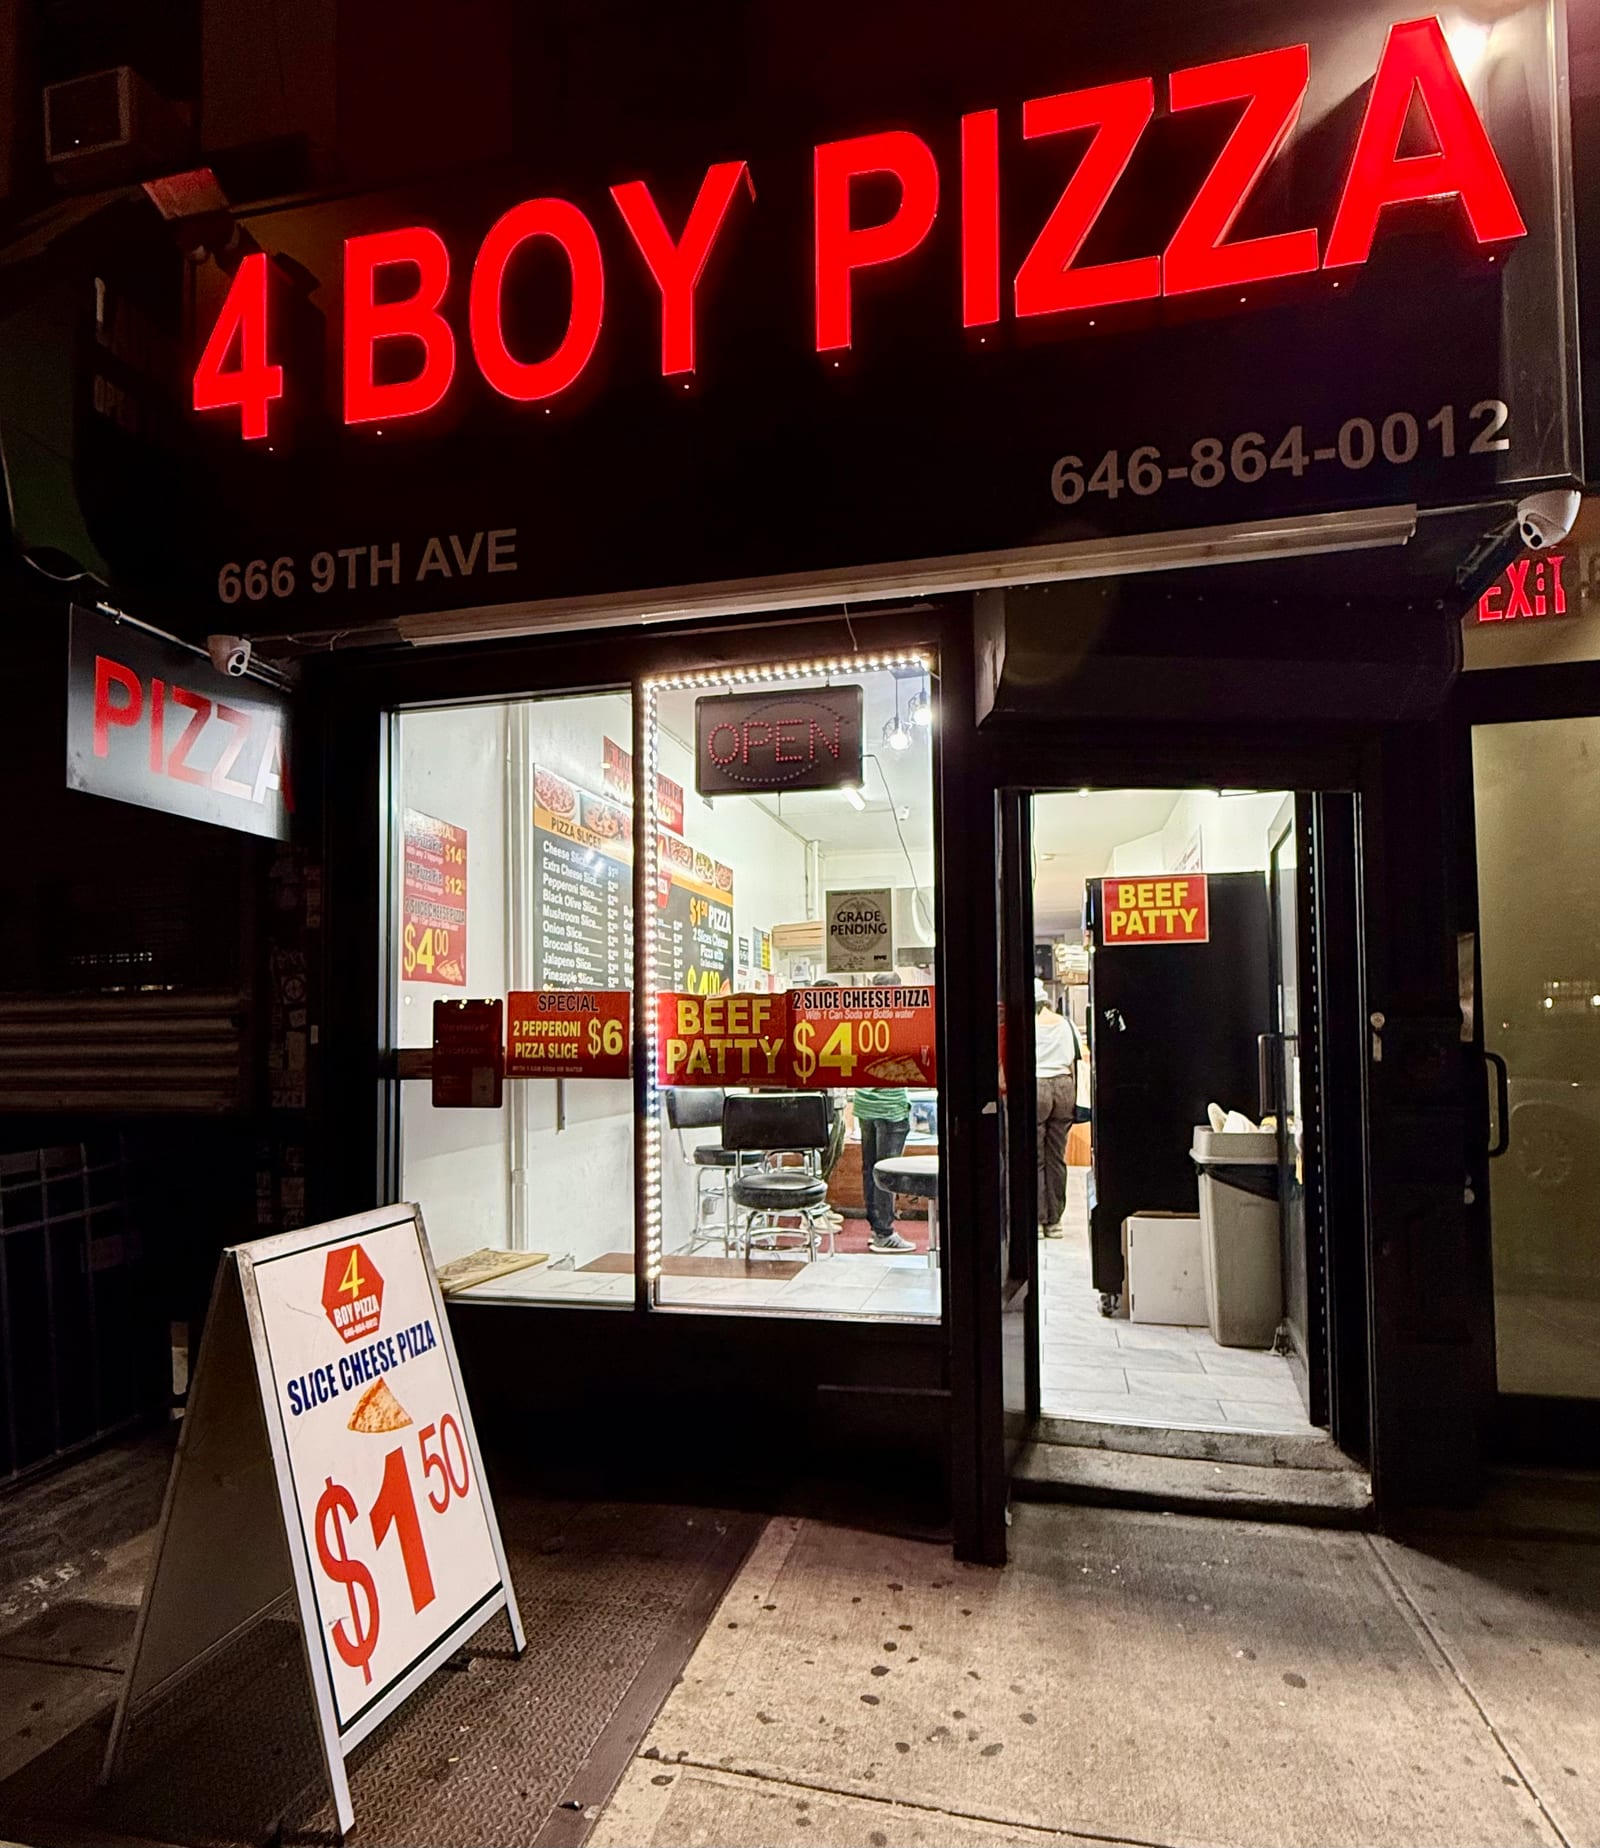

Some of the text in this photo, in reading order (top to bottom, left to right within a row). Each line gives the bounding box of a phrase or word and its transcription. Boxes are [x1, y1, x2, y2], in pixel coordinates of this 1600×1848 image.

[193, 14, 1528, 441] 4 BOY PIZZA
[1050, 400, 1511, 505] 646-864-0012
[218, 528, 518, 604] 666 9TH AVE
[93, 654, 296, 814] PIZZA
[707, 717, 841, 765] OPEN
[551, 817, 576, 840] PIZZA
[543, 840, 570, 861] Cheese
[543, 872, 579, 895] Pepperoni
[543, 888, 563, 905] Black
[1118, 882, 1189, 909] BEEF
[543, 904, 580, 924] Mushroom
[708, 904, 732, 935] PIZZA
[836, 910, 881, 923] GRADE
[1110, 907, 1199, 936] PATTY
[543, 920, 565, 936] Onion
[830, 923, 888, 936] PENDING
[543, 936, 572, 952] Broccoli
[543, 952, 575, 968] Jalapeno
[543, 967, 578, 984] Pineapple
[538, 995, 599, 1012] SPECIAL
[793, 989, 930, 1009] 2 SLICE CHEESE PIZZA
[677, 999, 771, 1035] BEEF
[829, 1010, 843, 1020] Can
[844, 1010, 863, 1020] Soda
[513, 1020, 581, 1037] 2 PEPPERONI
[587, 1017, 623, 1059] $6
[515, 1042, 579, 1059] PIZZA SLICE
[666, 1039, 784, 1075] PATTY
[338, 1248, 365, 1299] 4
[333, 1294, 380, 1329] BOY PIZZA
[287, 1319, 437, 1416] SLICE CHEESE PIZZA
